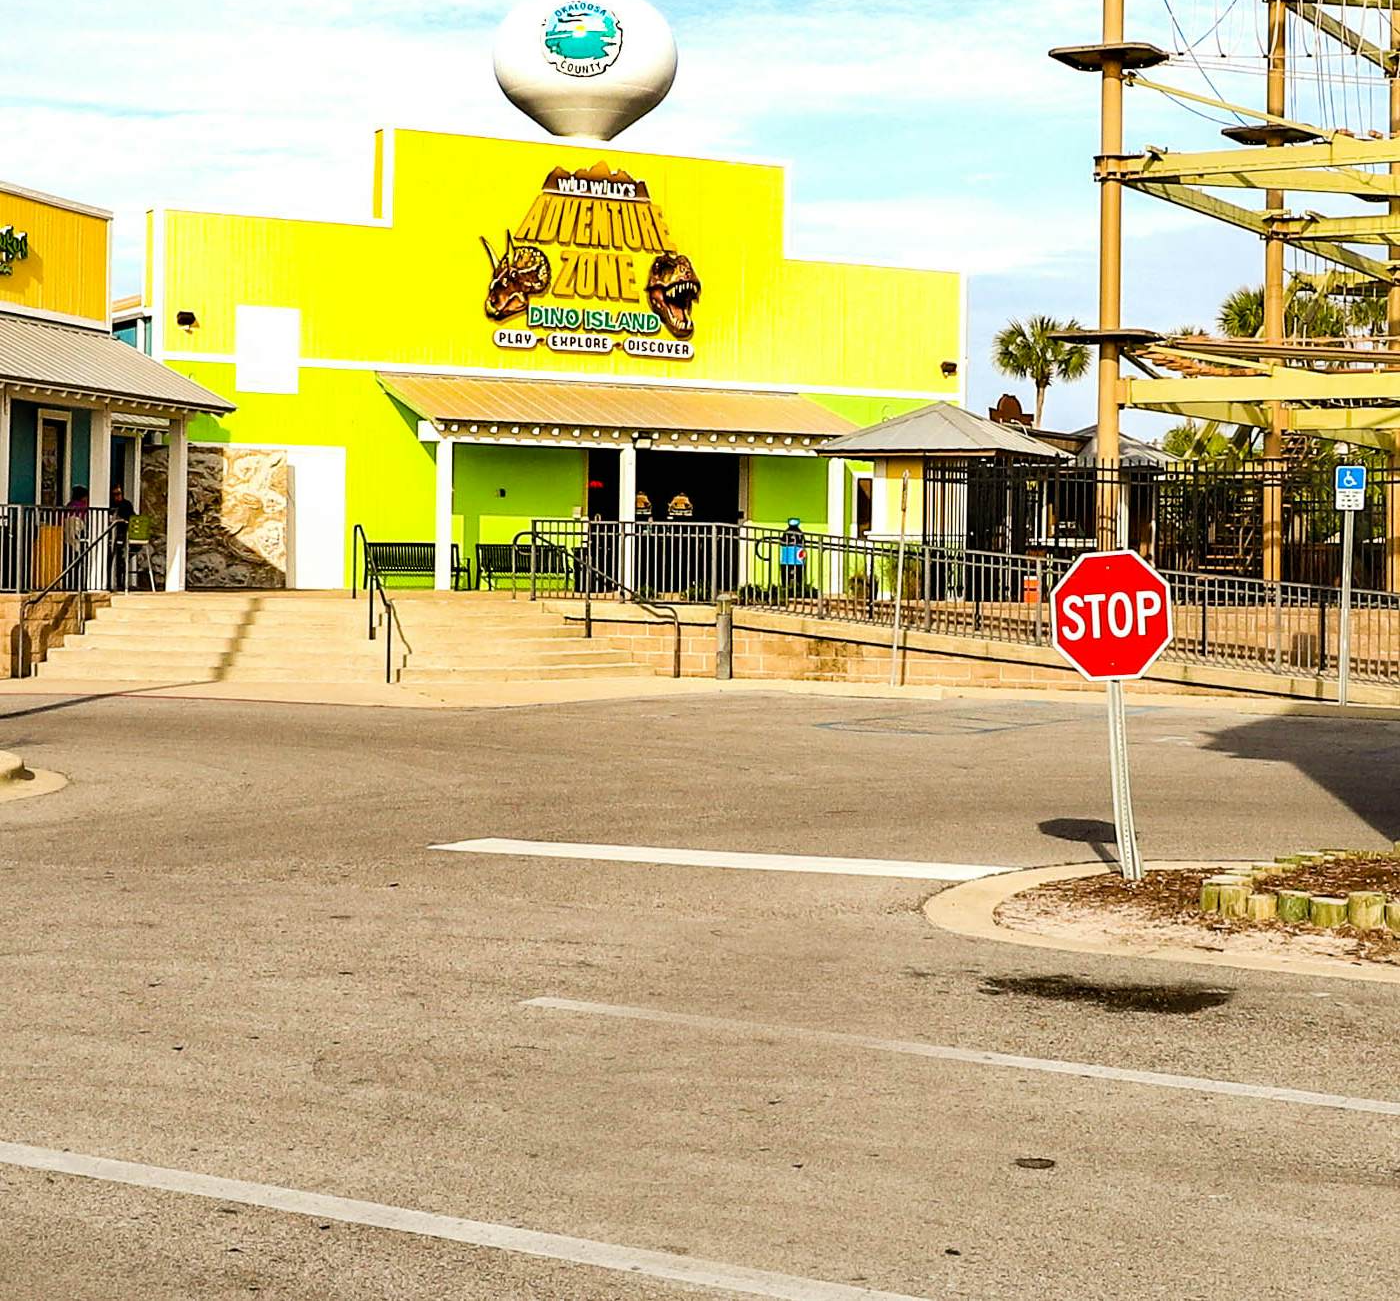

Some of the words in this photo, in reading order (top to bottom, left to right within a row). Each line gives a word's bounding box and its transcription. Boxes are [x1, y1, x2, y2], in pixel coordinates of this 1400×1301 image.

[555, 2, 607, 17] OKALOOSA
[560, 60, 601, 74] COUNTY
[558, 176, 588, 193] WILD
[590, 179, 636, 198] WILLY'S
[514, 195, 677, 253] ADVENTURE
[551, 251, 640, 303] ZONE
[529, 306, 580, 327] DINO
[585, 309, 661, 332] ISLAND
[499, 332, 532, 344] PLAY
[552, 335, 608, 349] EXPLORE
[628, 339, 689, 355] DISCOVER
[1061, 590, 1162, 641] STOP
